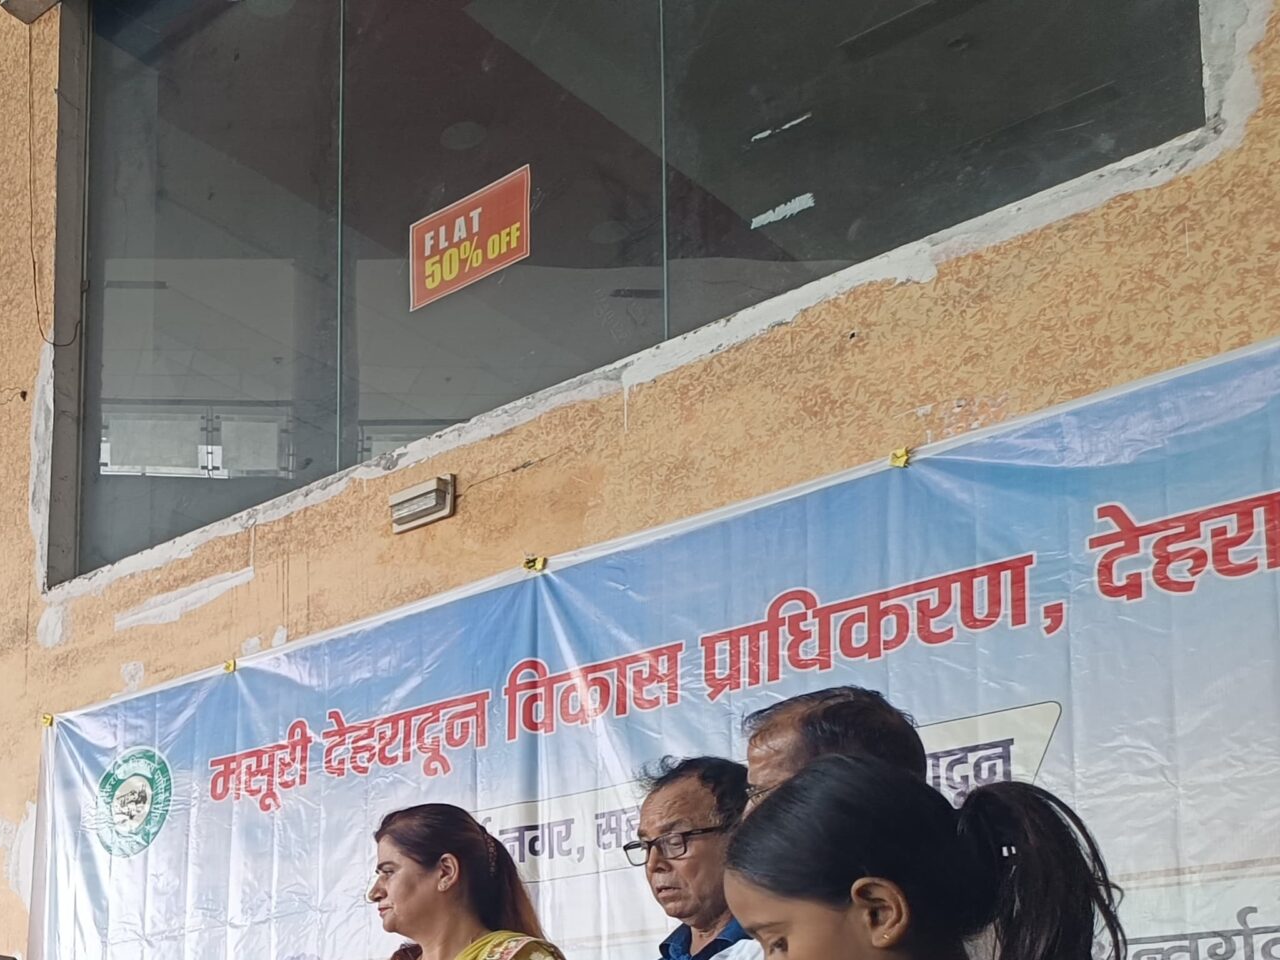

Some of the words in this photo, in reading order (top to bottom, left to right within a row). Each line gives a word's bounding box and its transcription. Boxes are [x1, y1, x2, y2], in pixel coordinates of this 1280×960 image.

[424, 207, 482, 256] FLAT
[424, 236, 483, 290] 50%
[487, 222, 520, 260] OFF
[209, 719, 313, 812] मसूरी
[322, 690, 491, 777] देहरादून
[504, 642, 684, 743] विकास
[699, 552, 1066, 703] प्राधिकरण,
[1087, 490, 1280, 603] देहरा
[926, 738, 1014, 808] ादून
